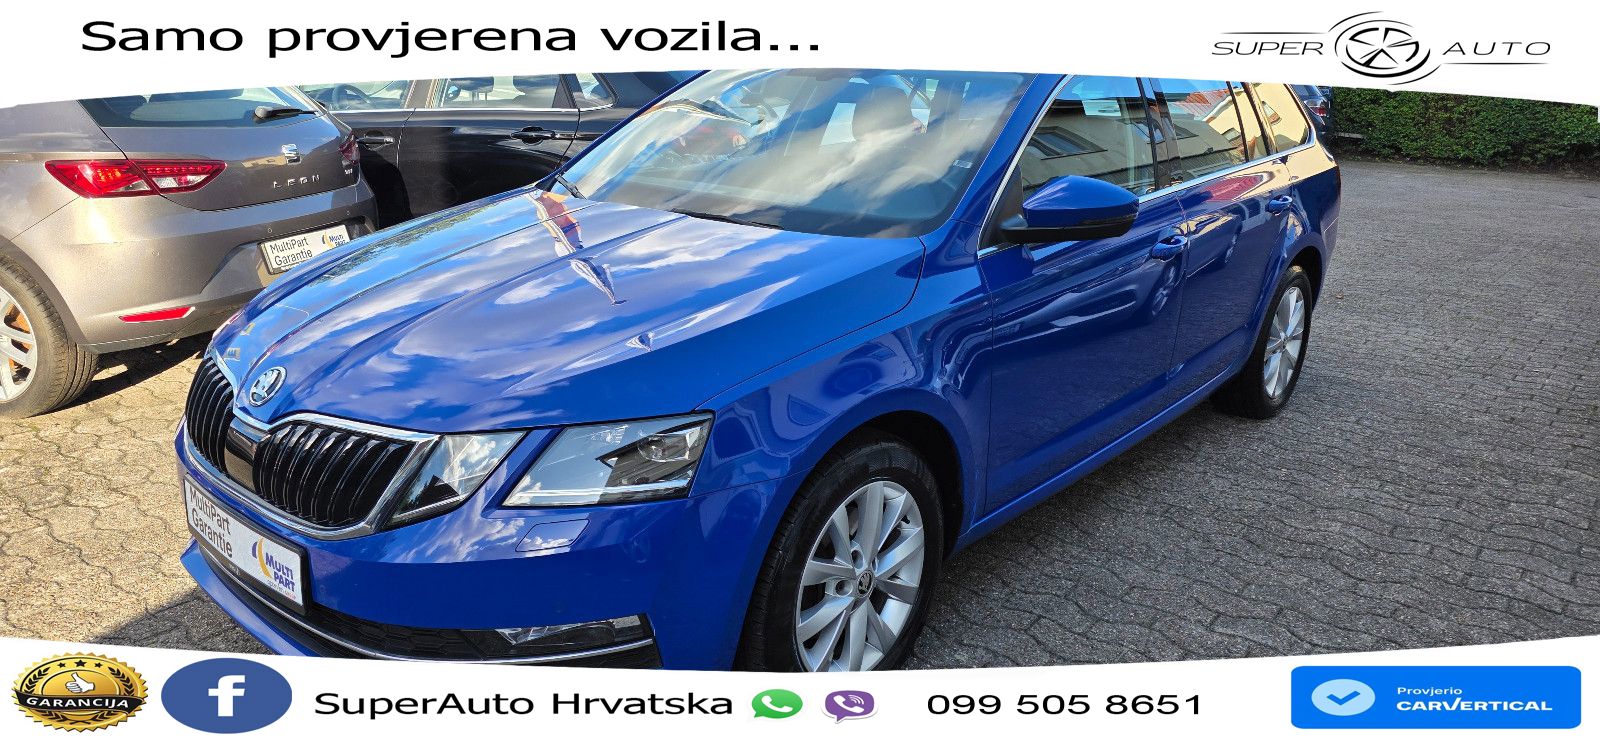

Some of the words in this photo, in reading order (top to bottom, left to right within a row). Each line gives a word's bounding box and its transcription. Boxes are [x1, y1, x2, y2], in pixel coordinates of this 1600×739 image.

[273, 175, 320, 189] LEON
[269, 236, 309, 254] MultiPart
[274, 248, 313, 266] Garantie
[189, 485, 231, 535] MultiPart
[192, 507, 233, 558] Garantie
[273, 570, 296, 592] PART
